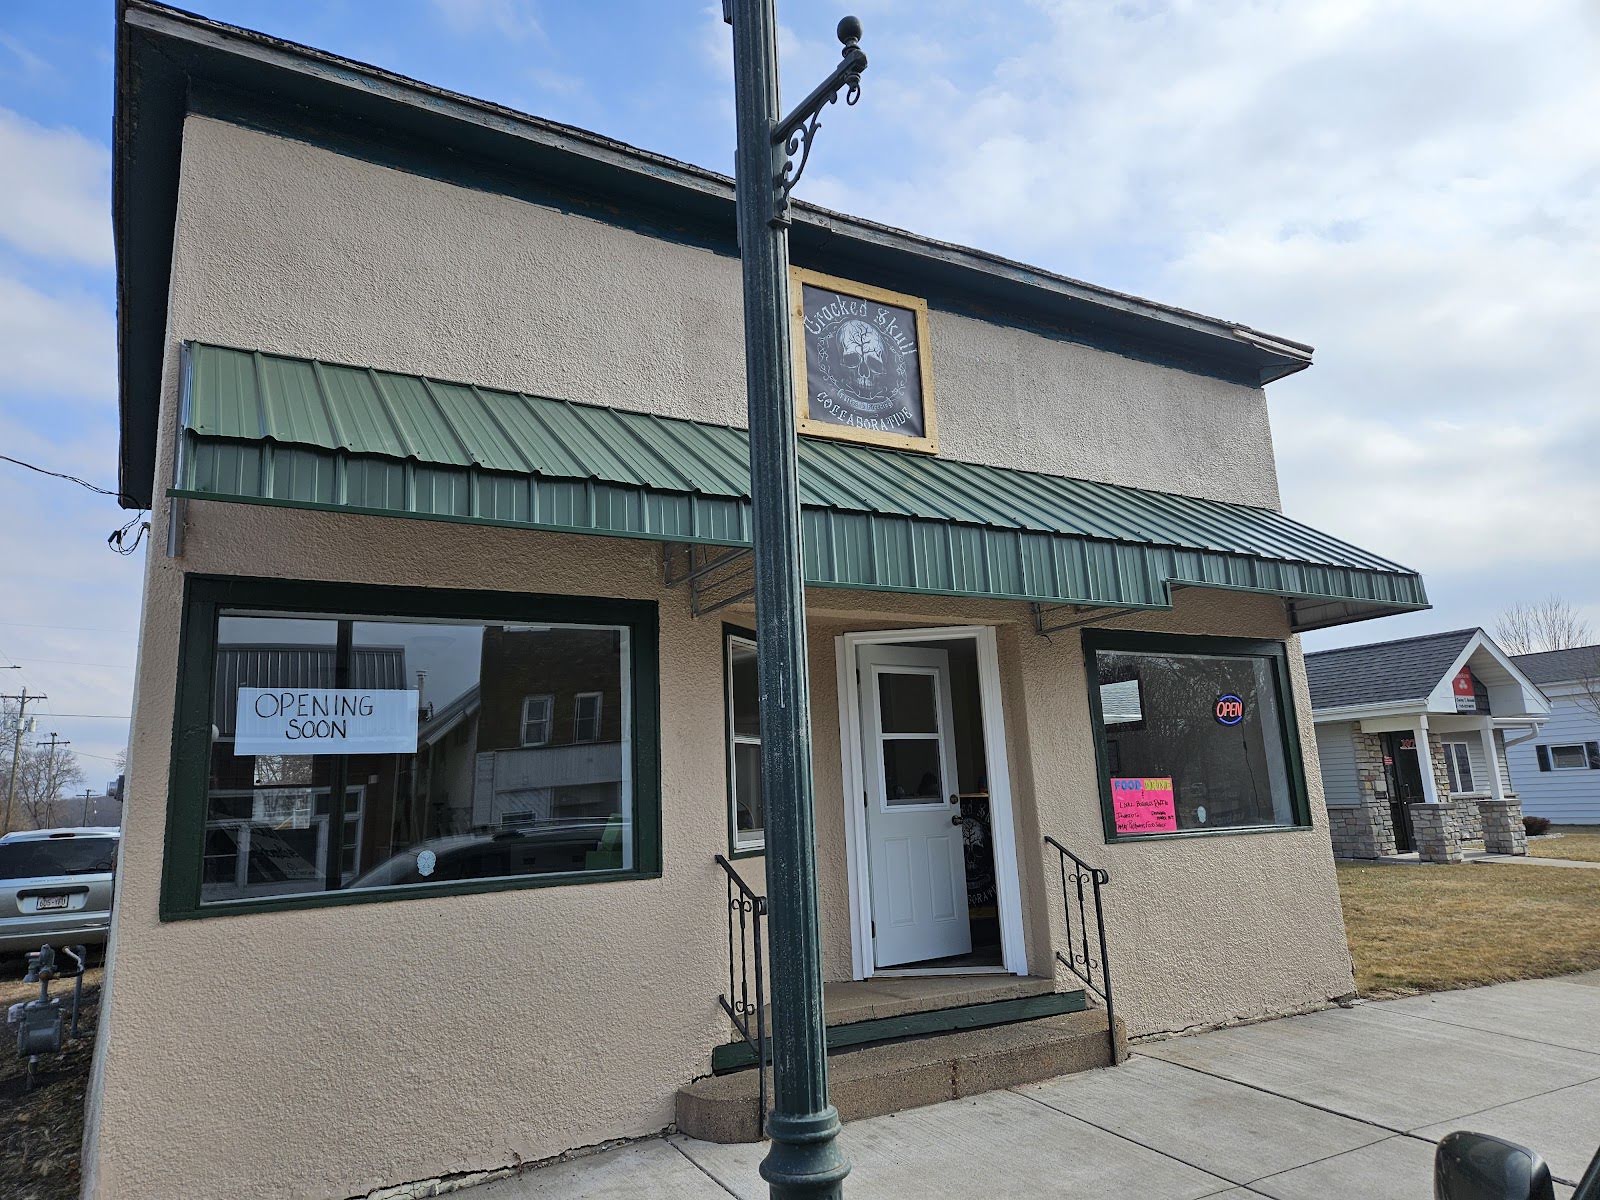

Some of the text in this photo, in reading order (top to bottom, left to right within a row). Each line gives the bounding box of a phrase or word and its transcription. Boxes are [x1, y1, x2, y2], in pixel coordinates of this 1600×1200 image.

[803, 295, 917, 355] Cracked Skull
[255, 692, 373, 718] OPENING
[1216, 701, 1242, 717] OPEN
[285, 718, 347, 740] SOON
[1115, 780, 1141, 790] FOOD
